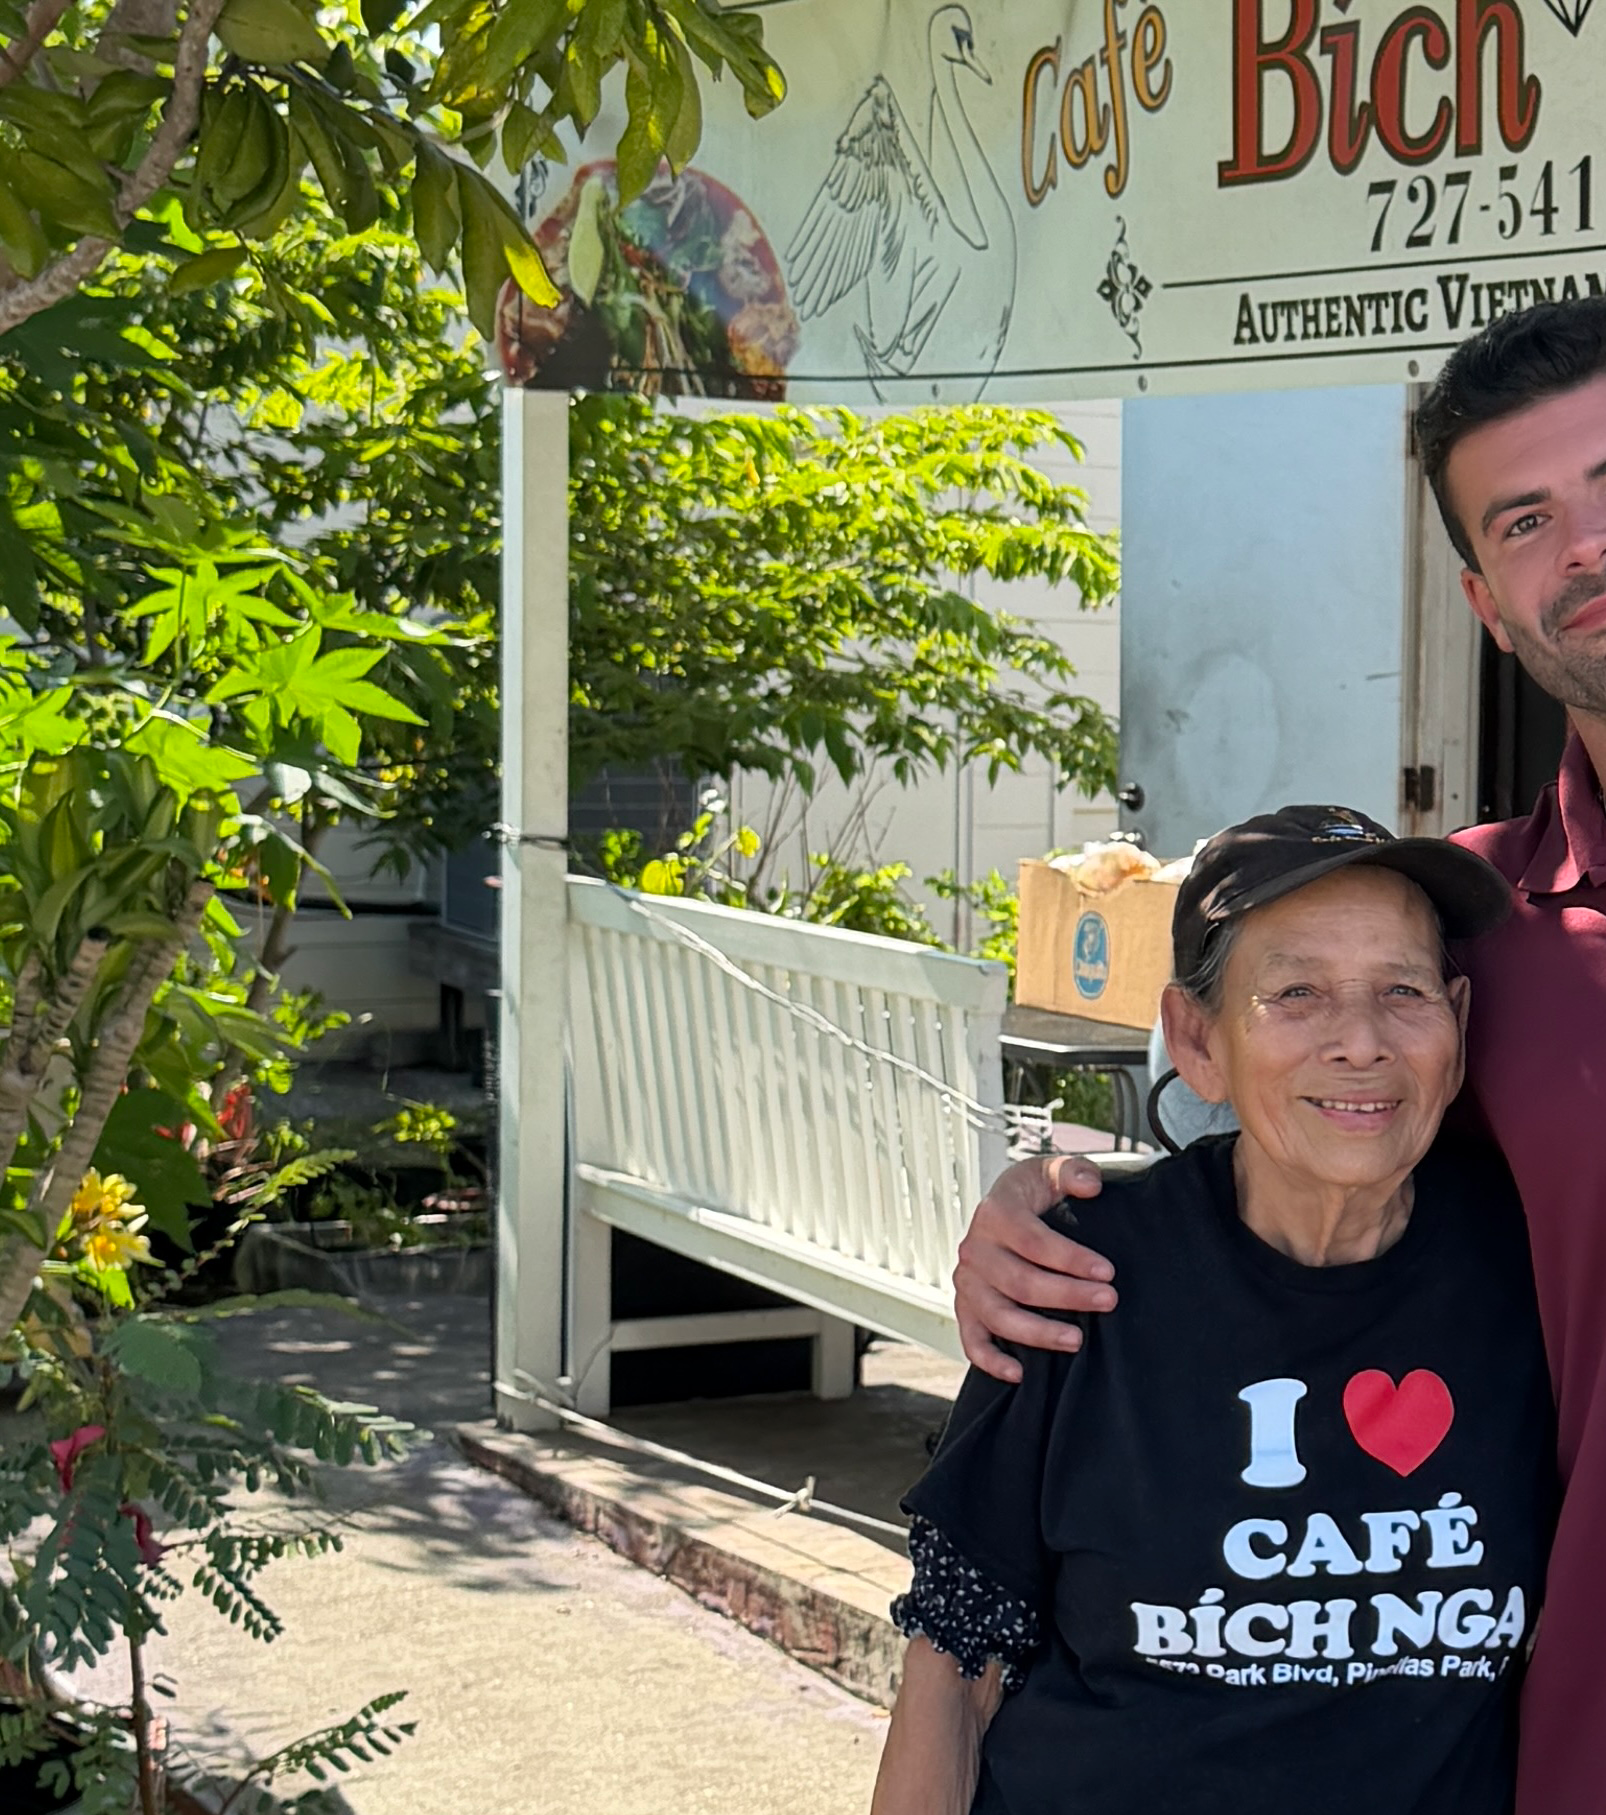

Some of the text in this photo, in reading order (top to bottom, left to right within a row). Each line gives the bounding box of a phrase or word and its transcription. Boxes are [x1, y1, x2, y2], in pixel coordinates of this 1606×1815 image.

[1217, 0, 1542, 189] Bich
[1237, 1377, 1308, 1489] I
[1222, 1491, 1485, 1581] CAFÉ
[1129, 1585, 1526, 1661] BÍCH NGA
[1272, 1662, 1340, 1688] Blvd,
[1440, 1654, 1496, 1683] Park,
